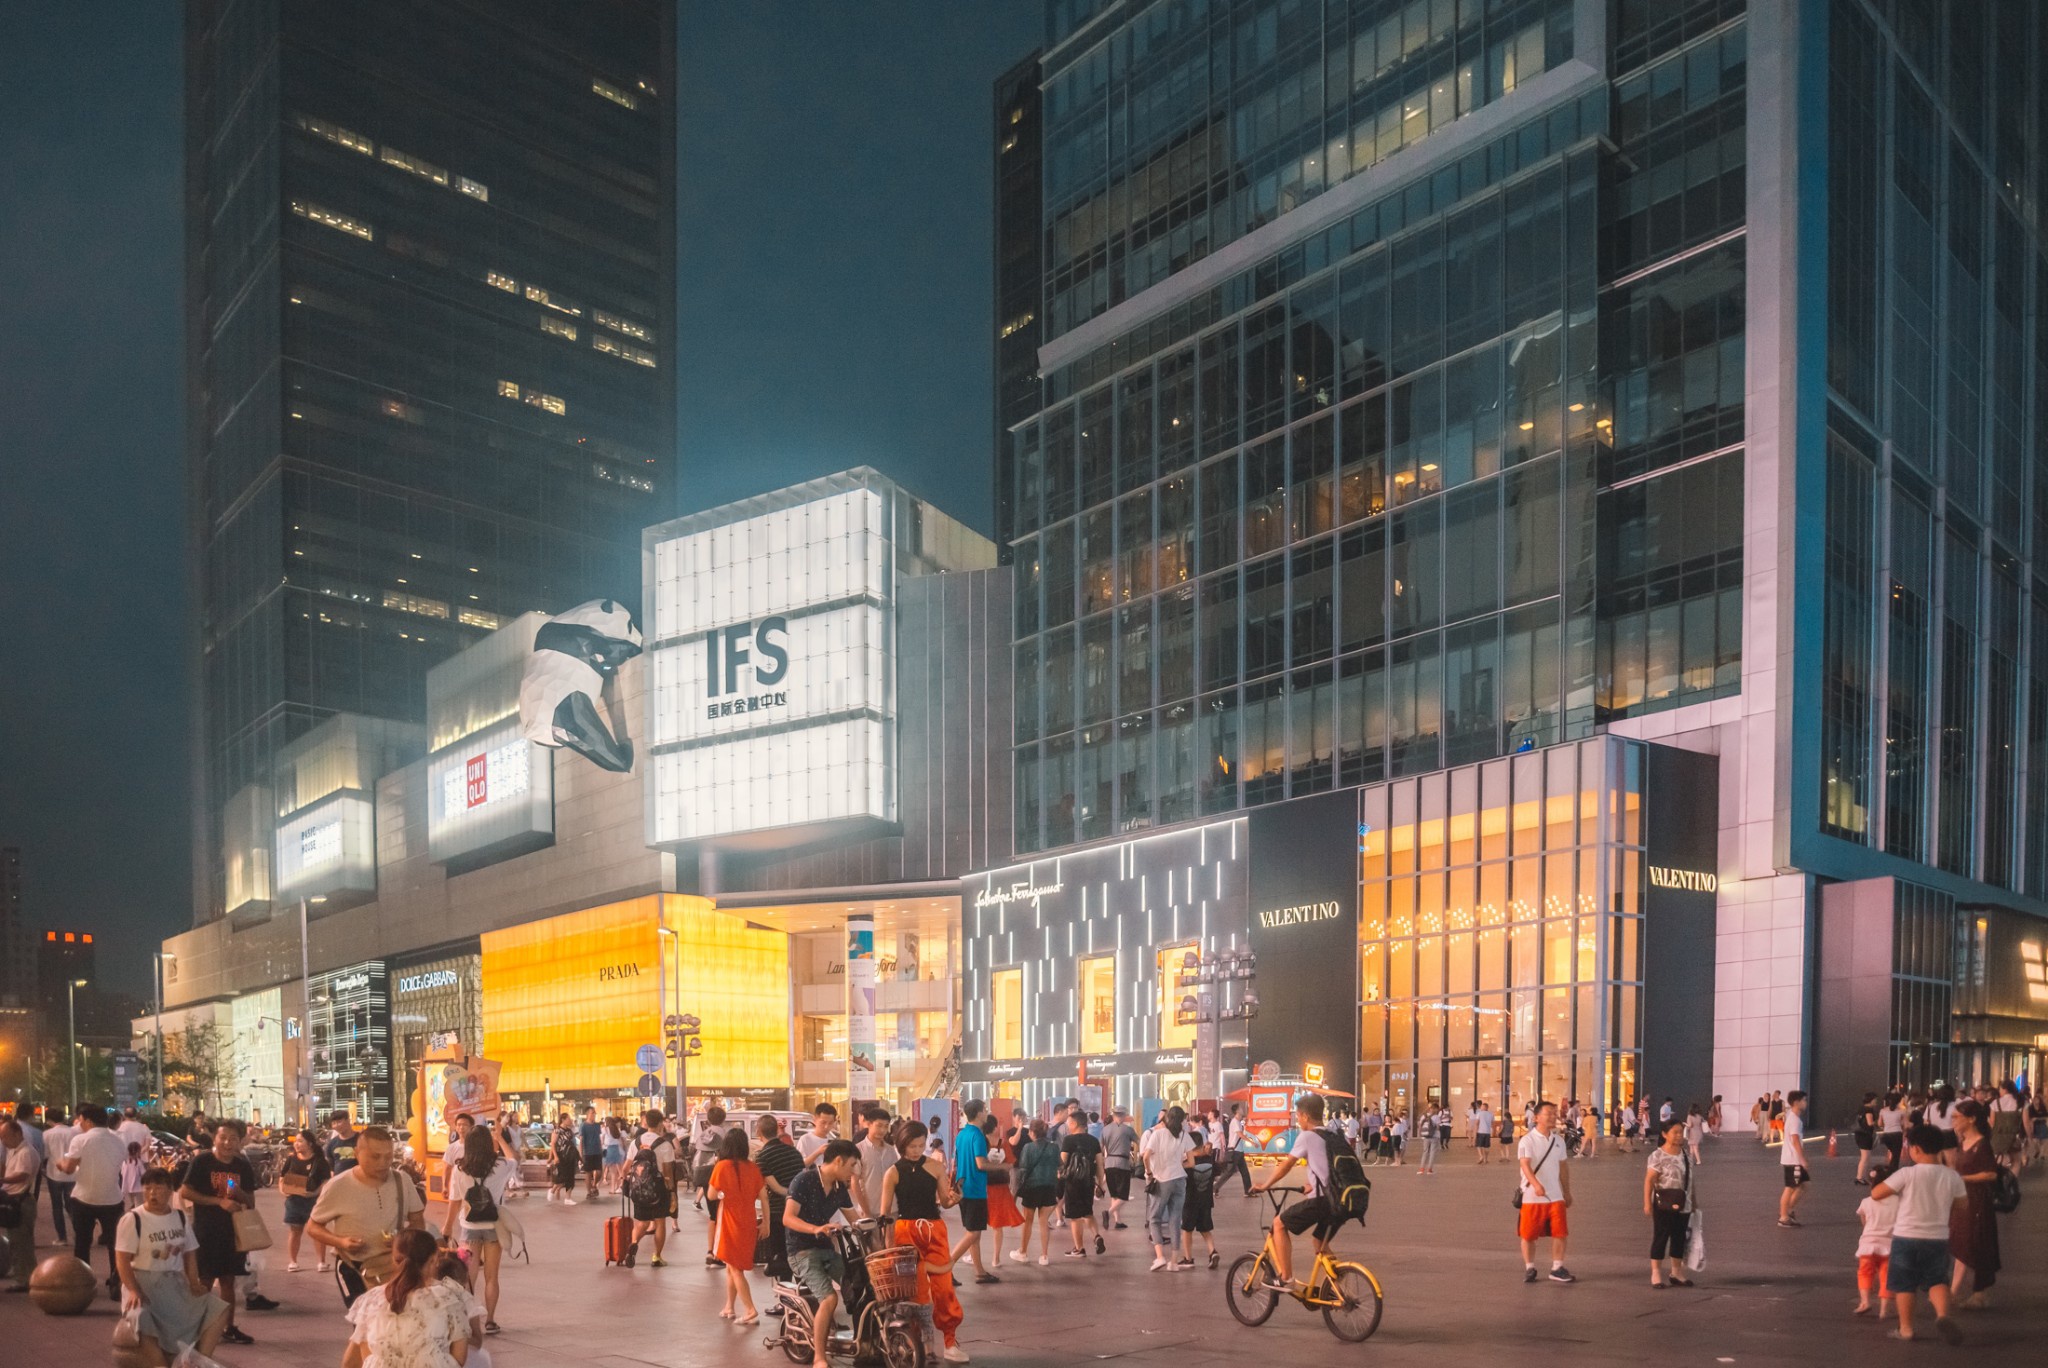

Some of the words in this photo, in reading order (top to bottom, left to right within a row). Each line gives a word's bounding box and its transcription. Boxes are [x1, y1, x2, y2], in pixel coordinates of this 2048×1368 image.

[707, 616, 789, 698] IFS
[707, 692, 787, 719] 国际金融中心
[468, 760, 484, 781] UNI
[468, 781, 486, 804] QLO
[1647, 865, 1717, 893] VALENTINO
[1259, 901, 1340, 928] VALENTINO
[599, 963, 640, 981] PRADA
[826, 961, 846, 975] Lan
